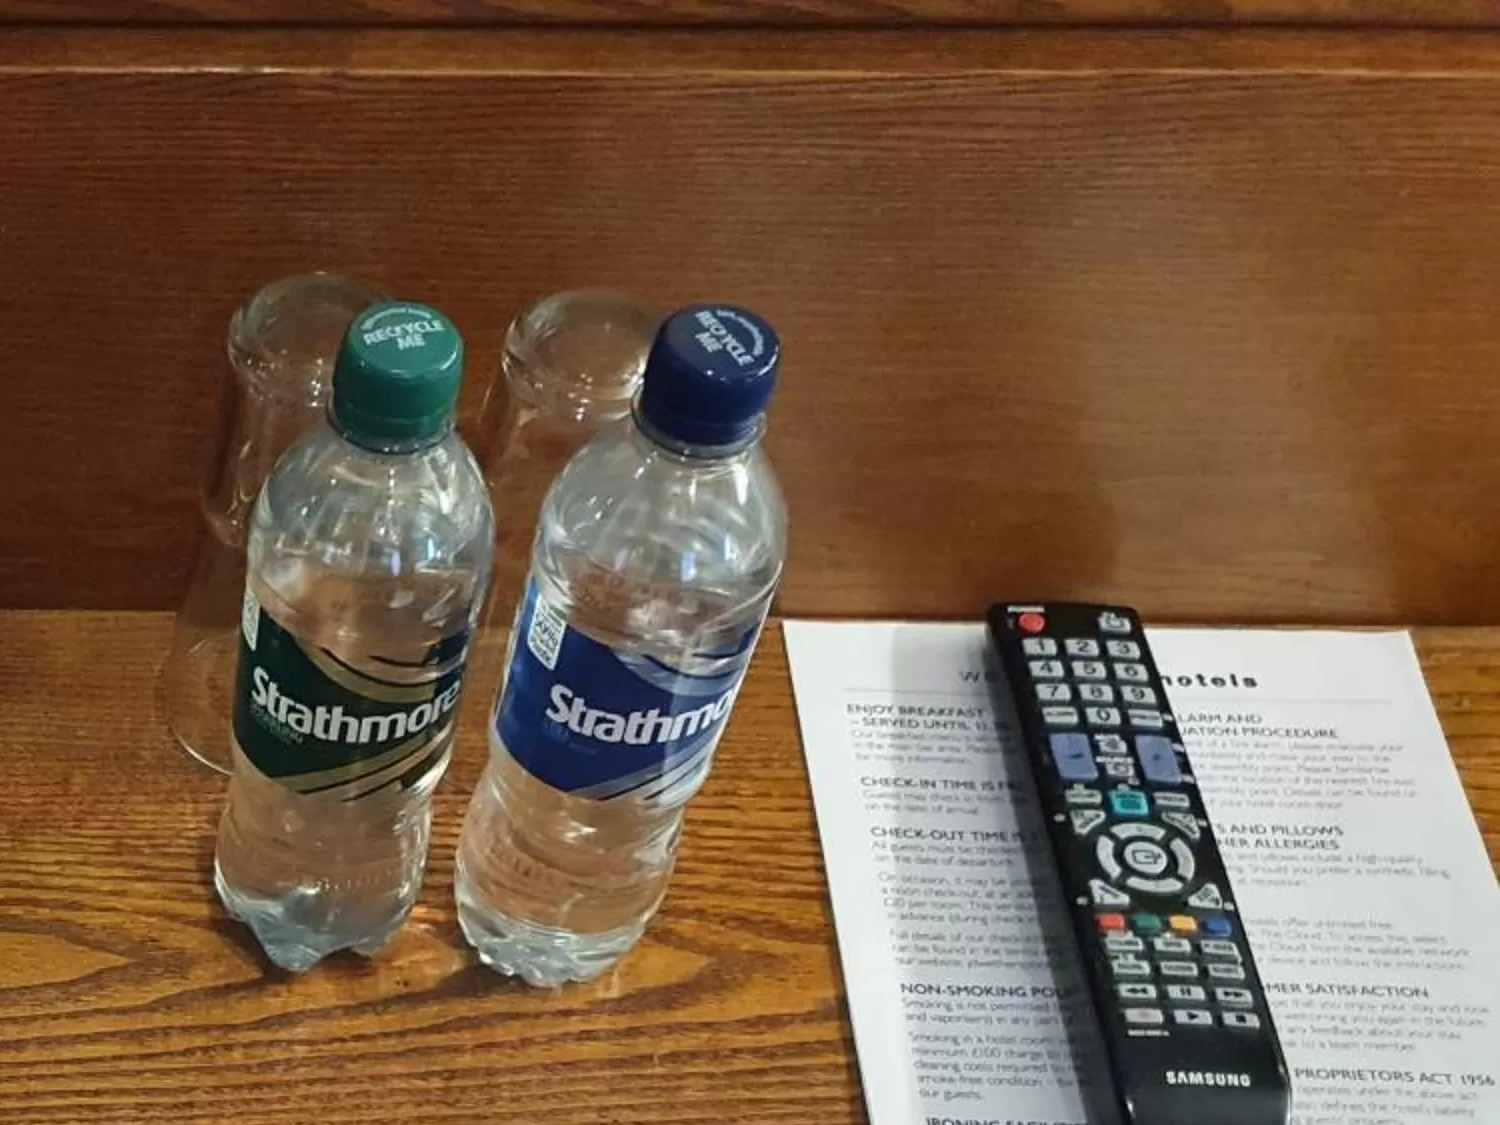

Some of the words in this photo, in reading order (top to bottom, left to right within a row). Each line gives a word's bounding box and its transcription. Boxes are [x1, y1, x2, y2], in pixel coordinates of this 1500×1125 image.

[363, 319, 446, 346] RECYCLE
[694, 310, 756, 367] RECYCLE
[396, 333, 426, 351] ME
[694, 331, 723, 353] ME
[250, 665, 462, 745] Strathmore
[846, 703, 894, 716] ENJOY
[897, 705, 984, 718] BREAKFAST
[862, 717, 920, 729] SERVED
[923, 719, 971, 731] UNTIL
[1178, 712, 1222, 724] LARM
[1241, 728, 1340, 740] PROCEDURE
[860, 776, 938, 789] CHECK-IN
[941, 778, 977, 790] TIME
[981, 780, 995, 791] IS
[870, 826, 964, 841] CHECK-OUT
[968, 829, 1008, 842] TIME
[1230, 823, 1268, 836] AND
[1270, 824, 1345, 837] PILLOWS
[1253, 837, 1341, 850] ALLERGIES
[900, 983, 1027, 998] NON-SMOKING
[1304, 983, 1430, 999] SATISFACTION
[1165, 1071, 1252, 1087] SAMSUNG
[1293, 1067, 1415, 1084] PROPRIETORS
[1418, 1071, 1454, 1085] ACT
